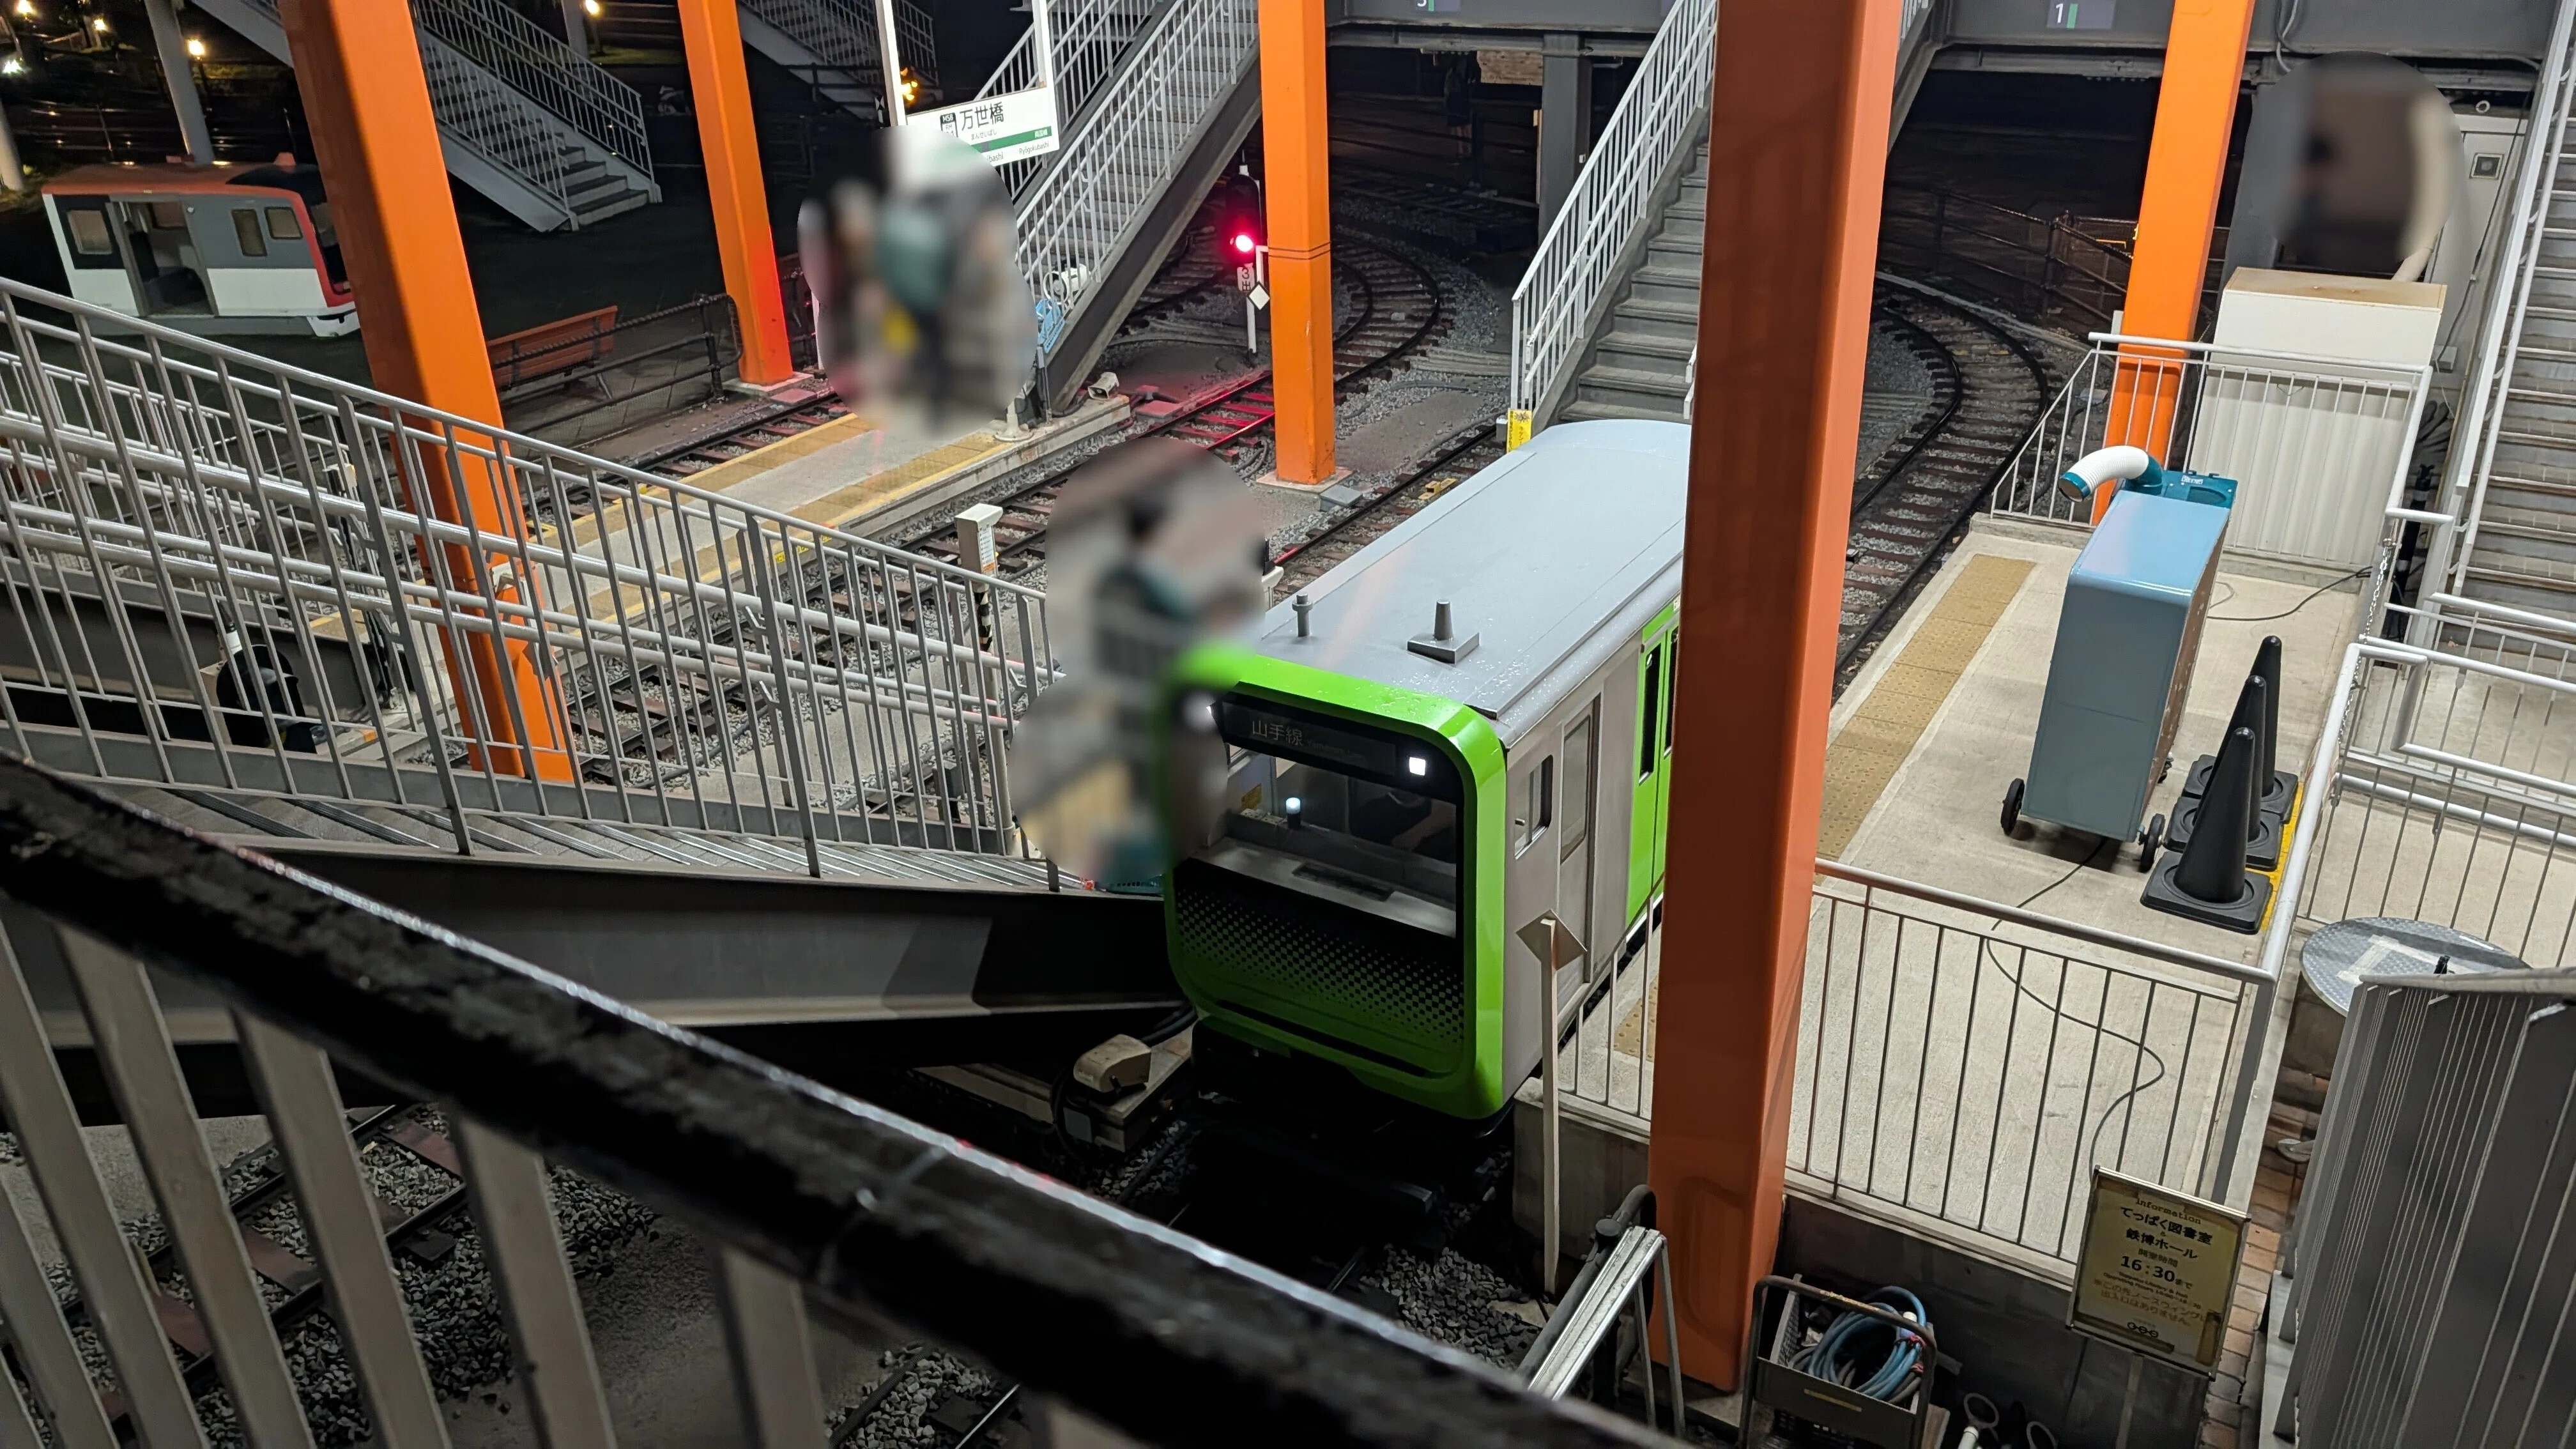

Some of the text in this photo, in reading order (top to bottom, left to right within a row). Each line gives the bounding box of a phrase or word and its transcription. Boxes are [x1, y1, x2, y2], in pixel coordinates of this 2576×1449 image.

[2056, 3, 2064, 23] 1
[960, 102, 1004, 131] 万世橋
[987, 151, 1004, 162] ibashi
[1241, 267, 1250, 280] 3
[1241, 280, 1251, 292] 出
[1252, 719, 1303, 746] 山手線
[2120, 1206, 2213, 1245] てっぱく図書室
[2126, 1228, 2198, 1259] 鉄博ホール
